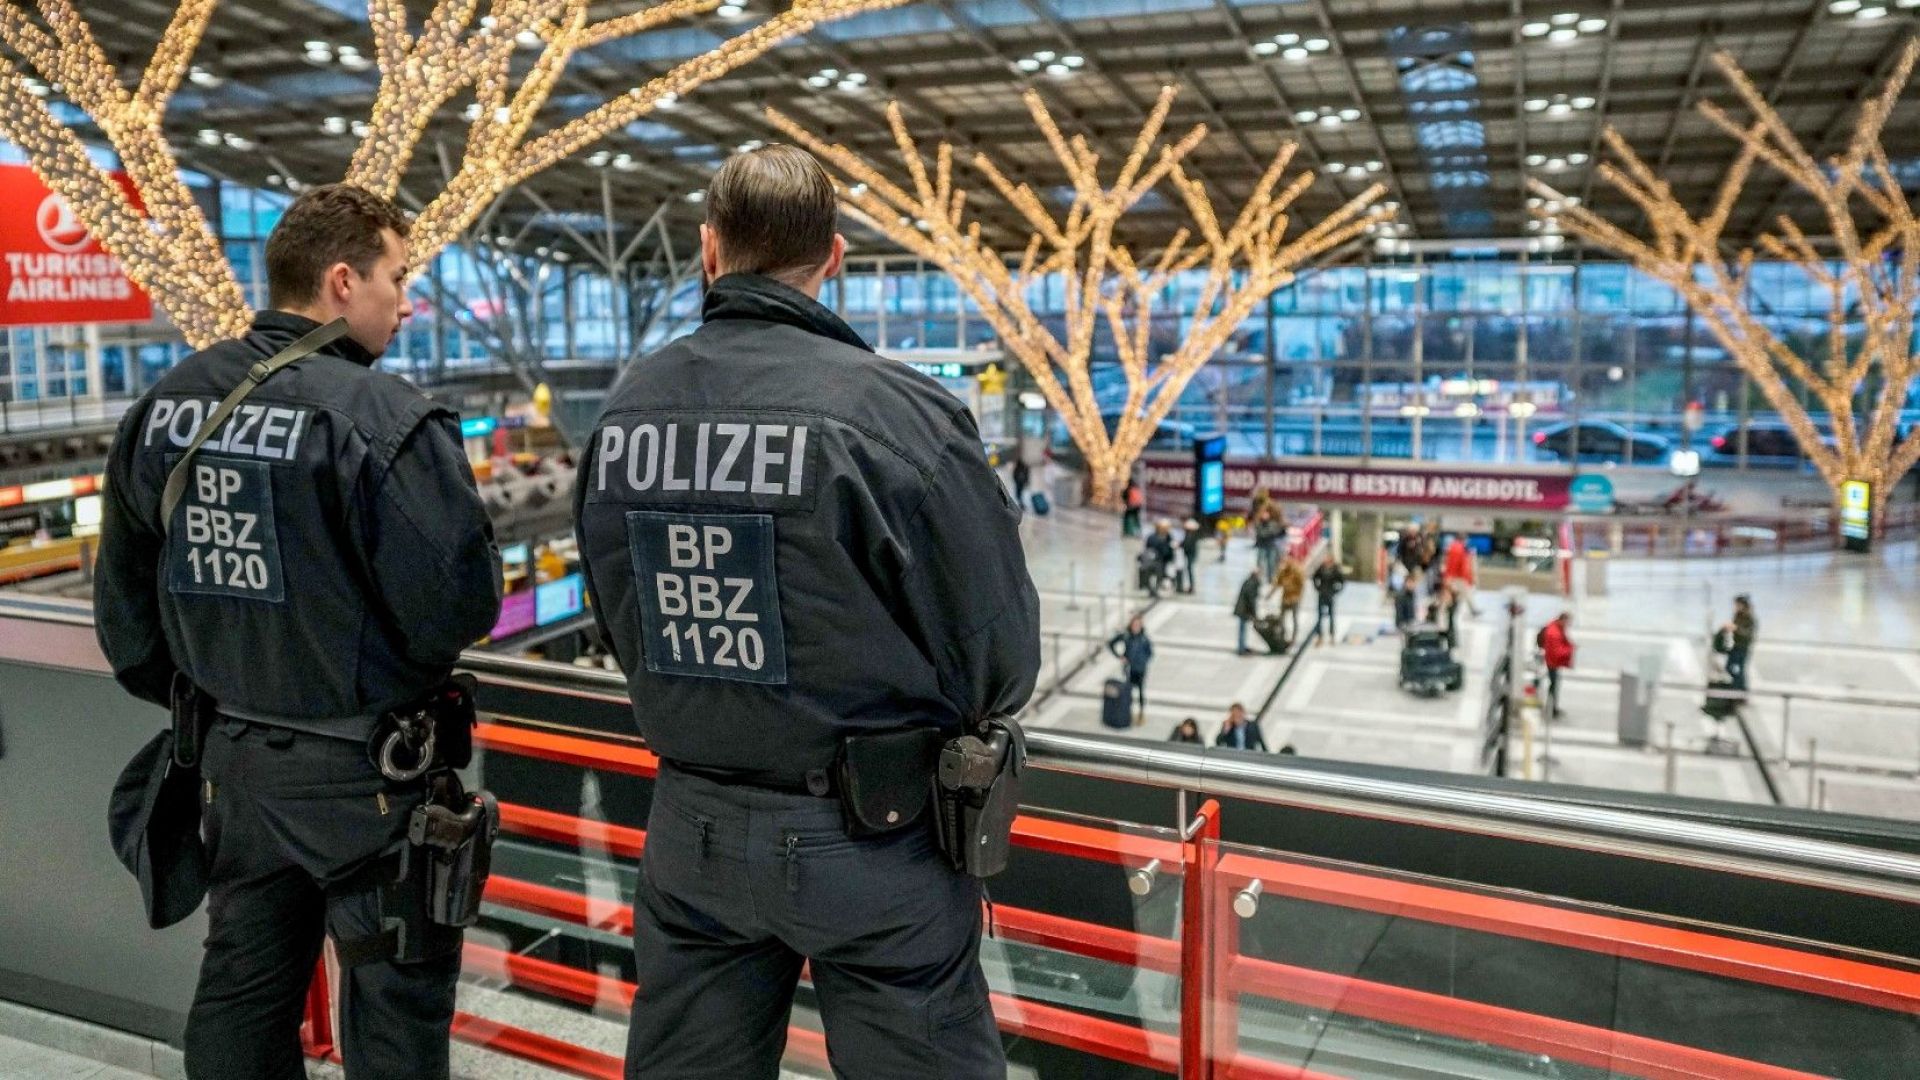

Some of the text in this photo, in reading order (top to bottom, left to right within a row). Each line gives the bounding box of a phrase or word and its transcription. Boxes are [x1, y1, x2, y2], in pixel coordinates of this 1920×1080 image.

[7, 277, 131, 301] AIRLINES
[145, 399, 305, 460] POLIZEI
[598, 423, 808, 496] POLIZEI
[195, 464, 242, 505] BP
[1223, 468, 1255, 492] ND
[1256, 469, 1313, 493] BREIT
[1313, 471, 1349, 495] DIE
[1352, 472, 1426, 498] BESTEN
[1428, 476, 1544, 501] ANGEBOTE.
[186, 505, 261, 550] BBZ
[668, 524, 733, 569] BP
[187, 547, 268, 590] 1120
[656, 572, 759, 622] BBZ
[662, 620, 765, 671] 1120
